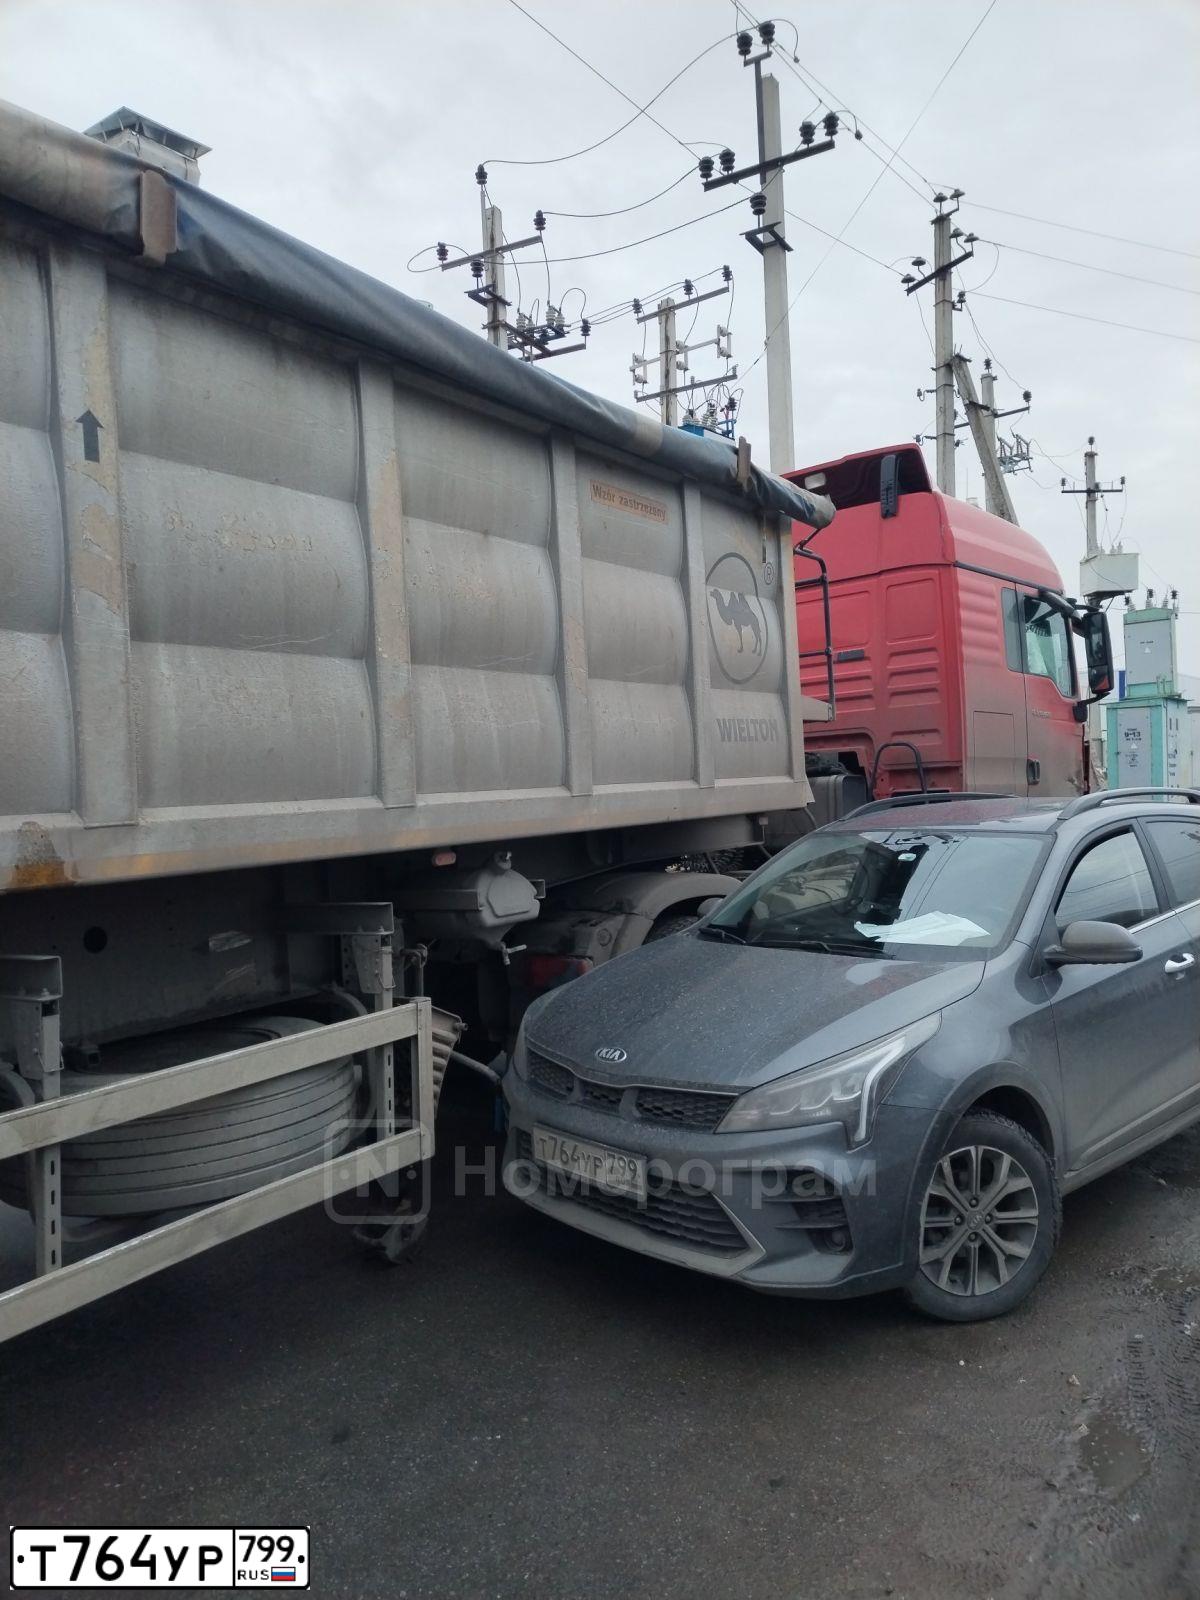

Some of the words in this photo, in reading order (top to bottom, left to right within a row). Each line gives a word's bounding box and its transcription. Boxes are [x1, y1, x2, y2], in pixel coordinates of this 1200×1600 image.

[715, 718, 778, 742] WIELTON
[598, 1048, 621, 1060] KIA
[606, 1150, 638, 1180] 799
